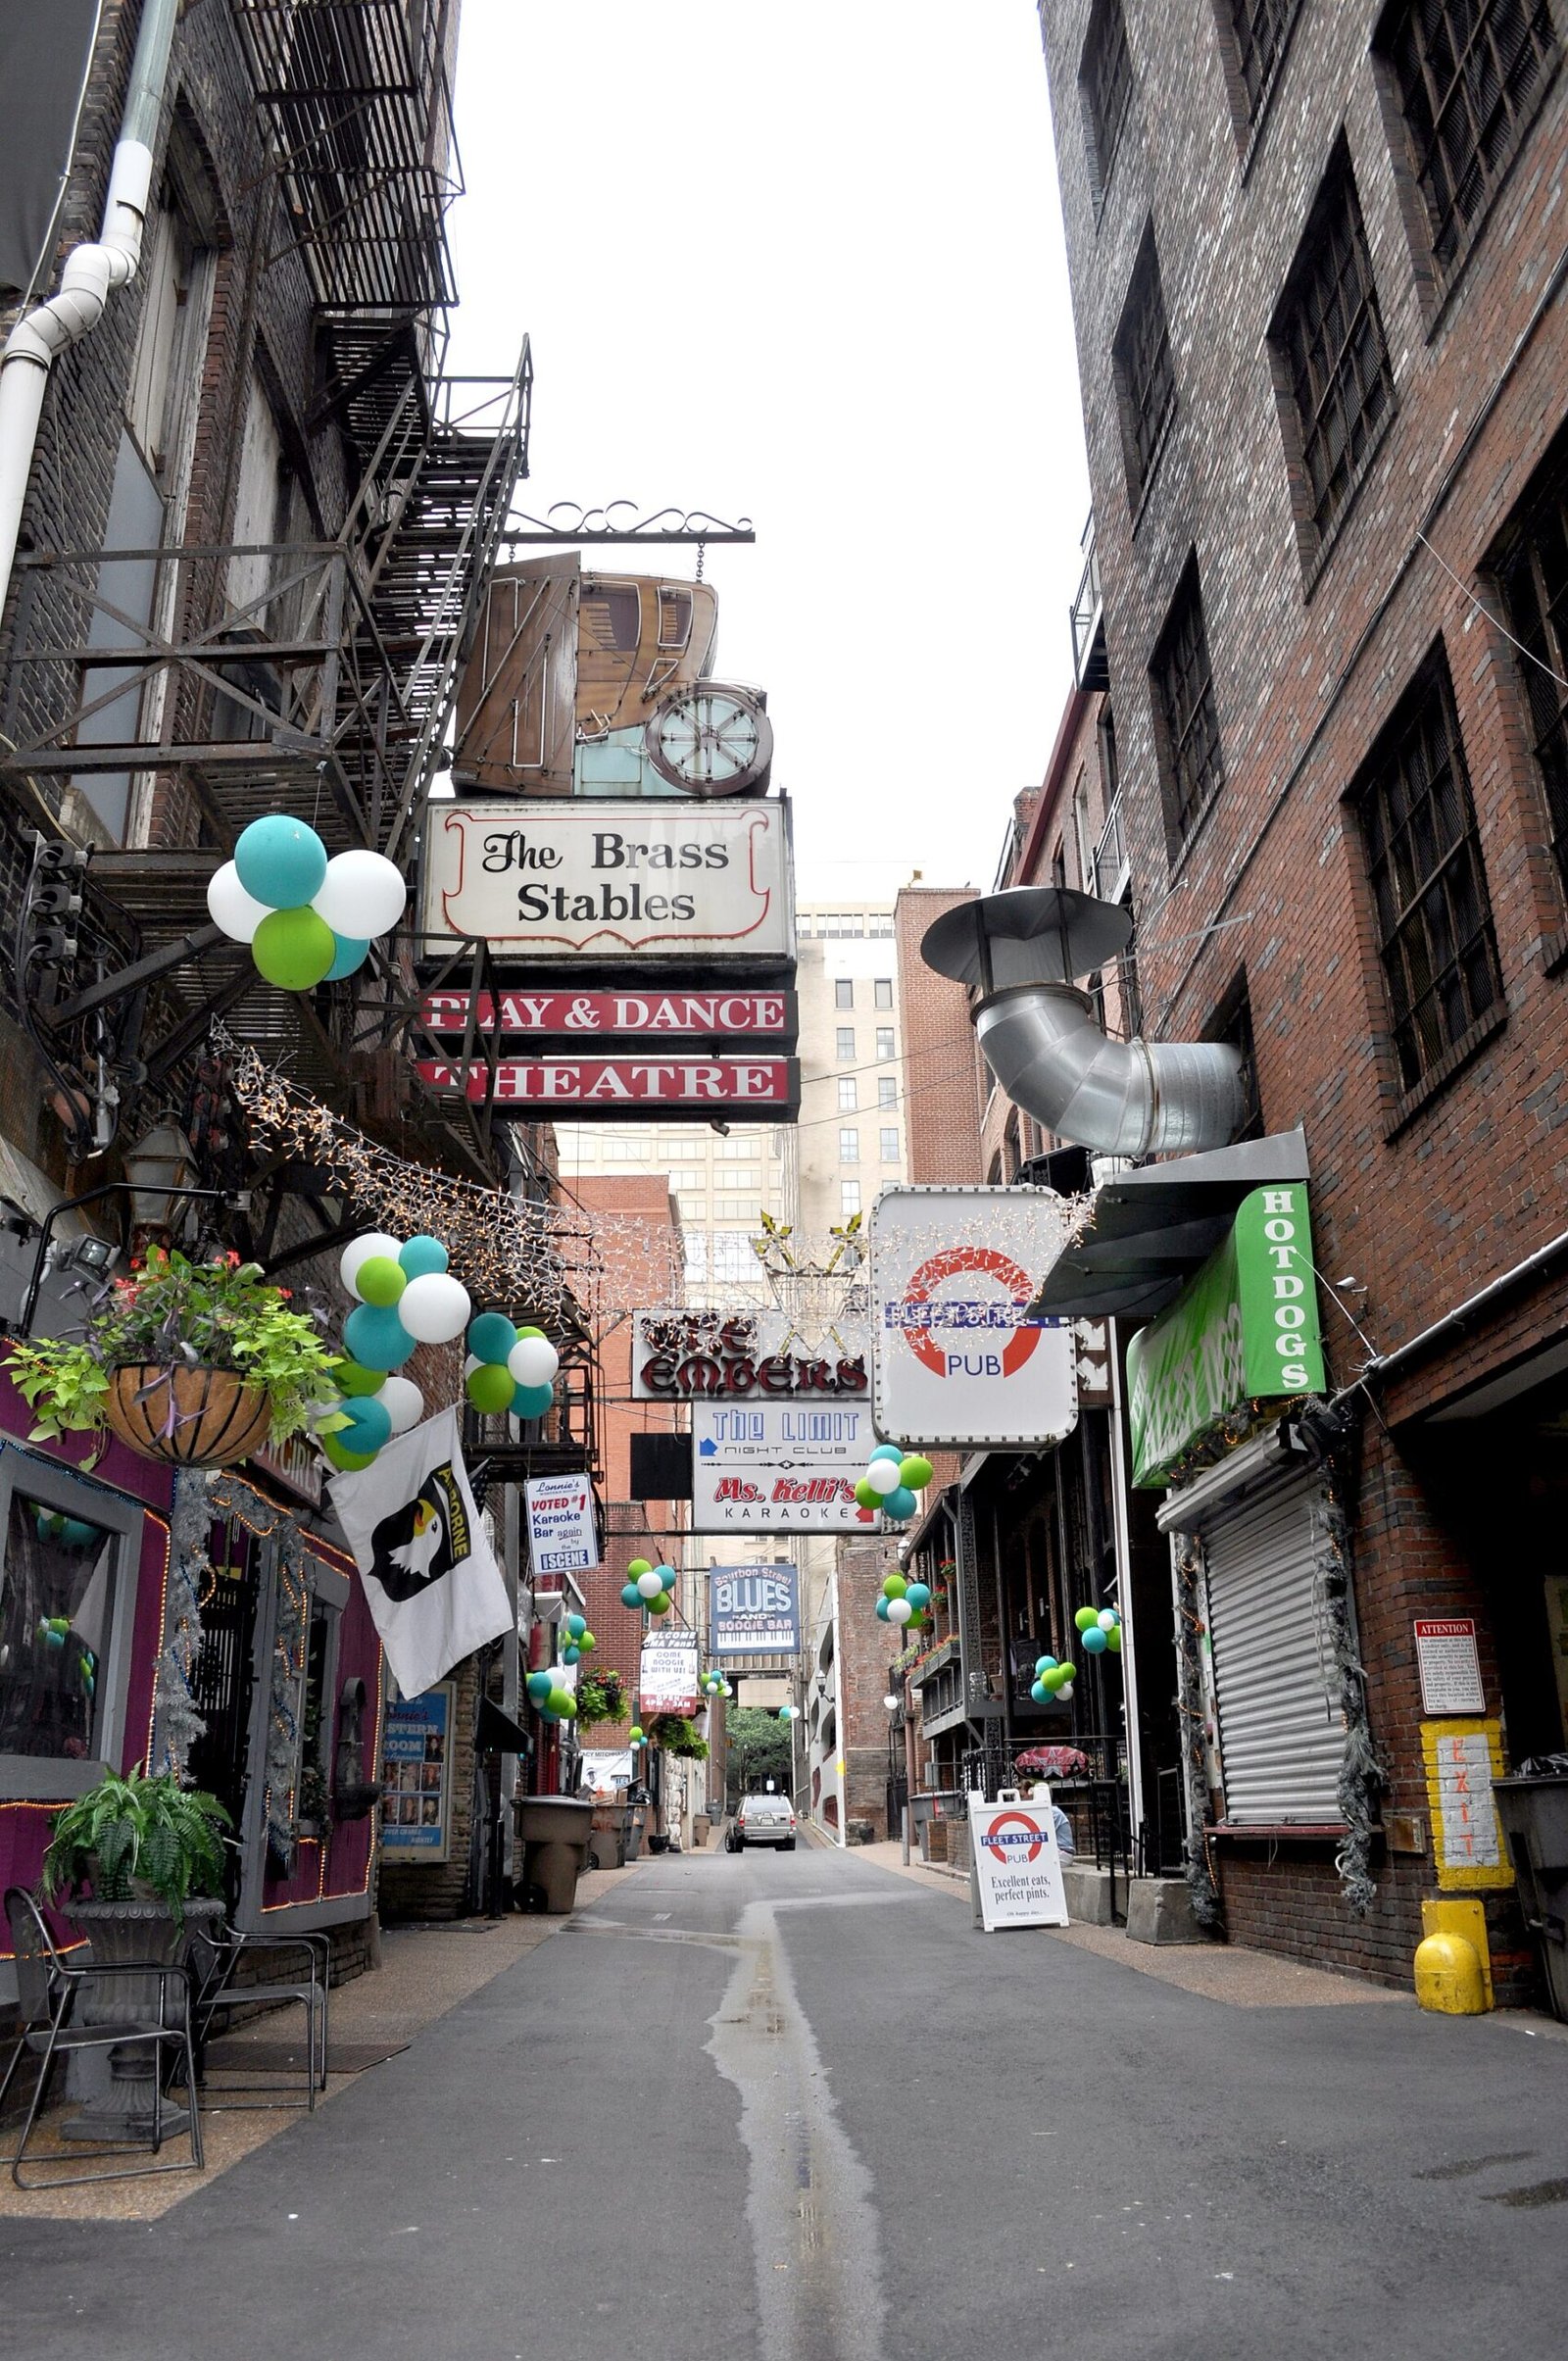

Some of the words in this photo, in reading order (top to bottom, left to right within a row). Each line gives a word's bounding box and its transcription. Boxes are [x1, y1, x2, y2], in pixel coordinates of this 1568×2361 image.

[482, 829, 564, 872] The
[591, 832, 730, 869] Brass
[517, 883, 696, 921] Stables
[564, 998, 600, 1028] &
[612, 998, 784, 1028] DANCE
[434, 1065, 774, 1099] THEATRE
[967, 1305, 1050, 1325] STRE
[948, 1354, 1001, 1376] PUB
[640, 1353, 868, 1395] EMBERS
[782, 1411, 859, 1441] LIMIT
[792, 1446, 847, 1454] CLUB
[536, 1478, 580, 1493] Lonnie's
[712, 1477, 766, 1502] Ms.
[769, 1476, 857, 1503] Kelli's
[532, 1498, 568, 1511] VOTED
[532, 1510, 581, 1526] Karaoke
[724, 1507, 849, 1519] KARAOKE
[534, 1527, 554, 1539] Bar
[558, 1526, 582, 1539] again
[548, 1549, 587, 1568] SCENE
[714, 1568, 759, 1587] Bourbon
[716, 1578, 792, 1613] BLUES
[717, 1620, 764, 1632] BOOGIE
[767, 1619, 793, 1631] BAR
[1421, 1624, 1469, 1635] ATTENTION
[651, 1631, 697, 1640] ELCOME
[384, 1740, 422, 1751] OOM
[1451, 1739, 1474, 1857] EXIT
[982, 1836, 1010, 1845] FLEET
[1011, 1833, 1046, 1843] STREET
[1006, 1853, 1028, 1864] PUB
[991, 1875, 1029, 1889] Excellent
[1031, 1876, 1051, 1886] eats,
[995, 1888, 1025, 1904] perfect
[1026, 1888, 1050, 1902] pints.
